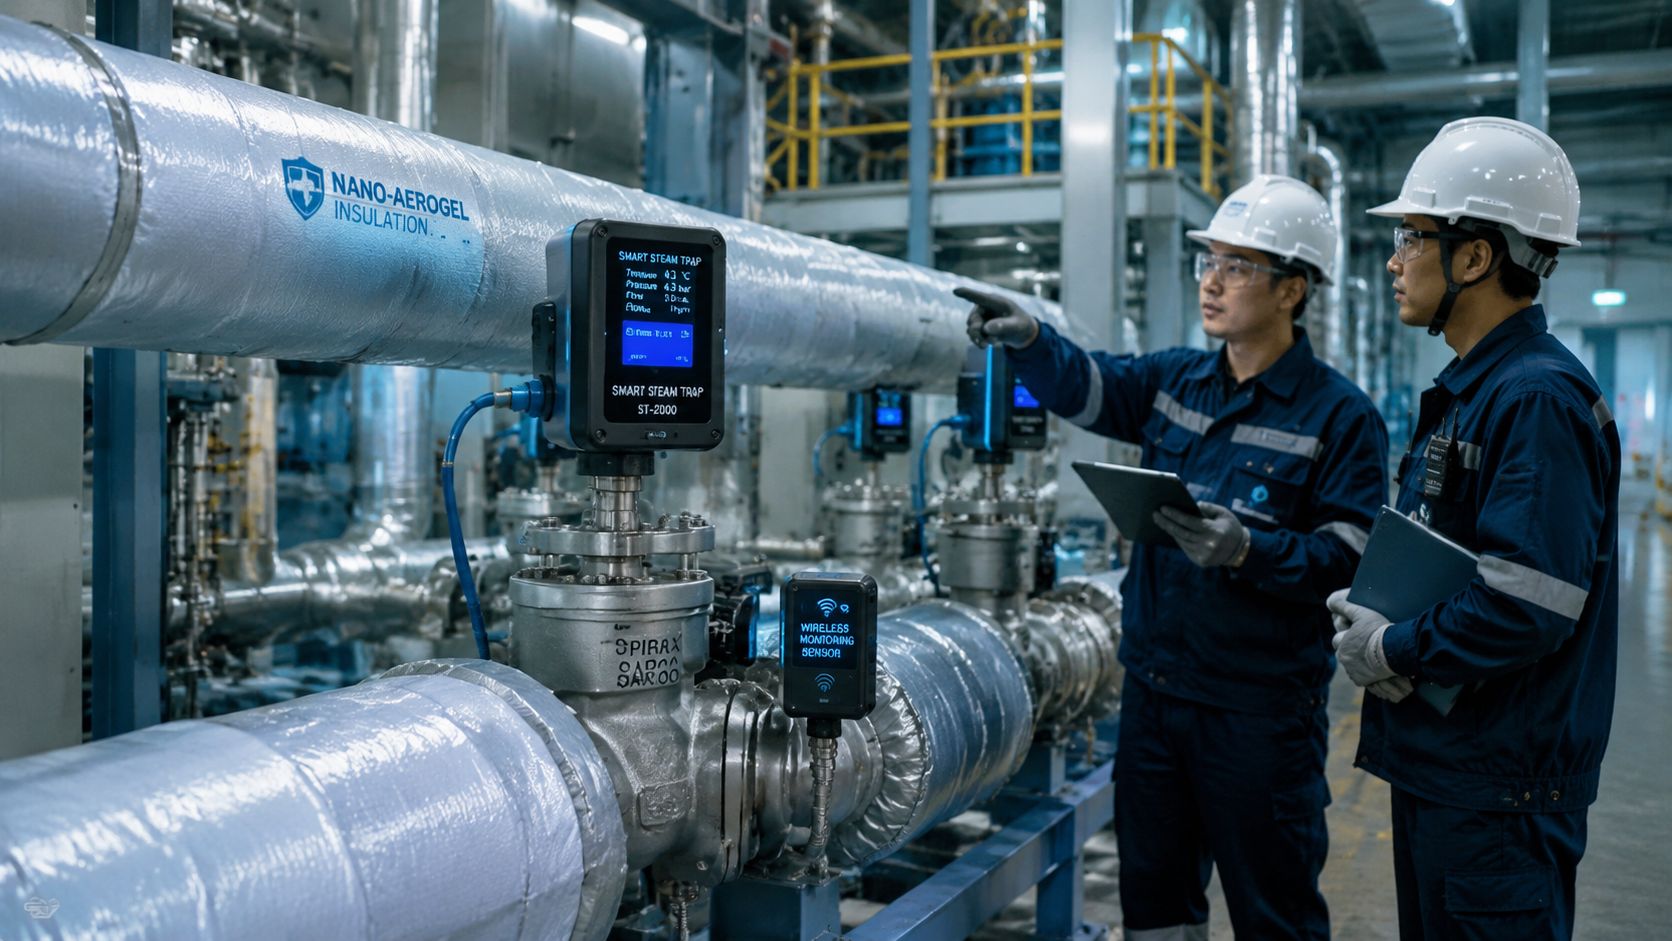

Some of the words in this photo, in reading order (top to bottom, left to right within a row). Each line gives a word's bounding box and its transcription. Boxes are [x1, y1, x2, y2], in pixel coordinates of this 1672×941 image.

[331, 171, 470, 222] NANO-AEROGEL
[618, 250, 648, 263] SMART
[650, 253, 679, 264] STEAM
[680, 255, 702, 267] TRAP
[612, 384, 645, 397] SMART
[648, 385, 678, 398] STEAM
[680, 386, 705, 398] TRAP
[637, 404, 678, 416] ST-2000
[800, 623, 850, 634] WIRELESS
[615, 633, 682, 657] SPIRAX
[801, 647, 841, 658] SENSOR
